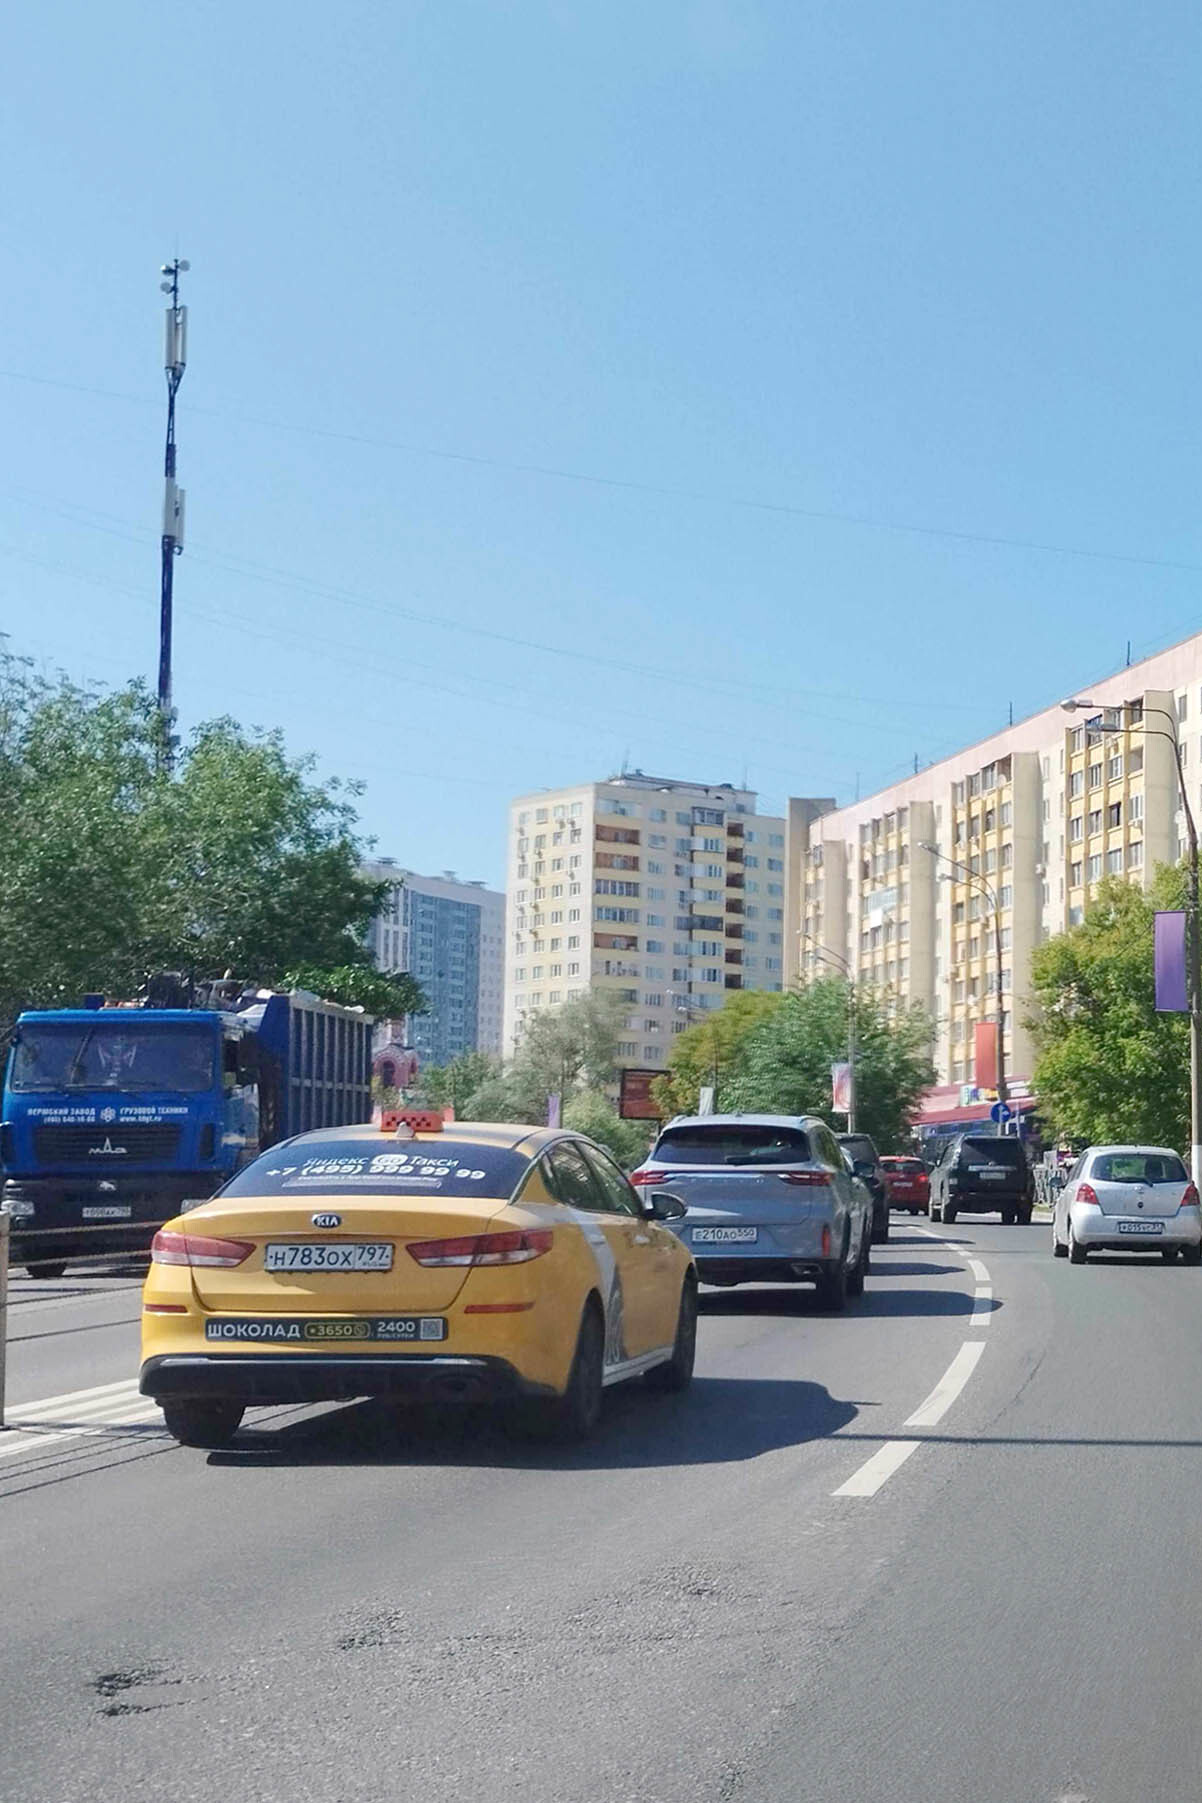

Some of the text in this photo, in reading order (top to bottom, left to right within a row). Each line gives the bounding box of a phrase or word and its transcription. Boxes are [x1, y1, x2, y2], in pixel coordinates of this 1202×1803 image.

[303, 1156, 370, 1167] Яндекс
[409, 1155, 460, 1167] Такси
[266, 1164, 487, 1180] +7 (495) 999 99 99
[316, 1216, 339, 1227] KIA
[207, 1323, 301, 1339] ШОКОЛАД
[377, 1320, 416, 1333] 2400
